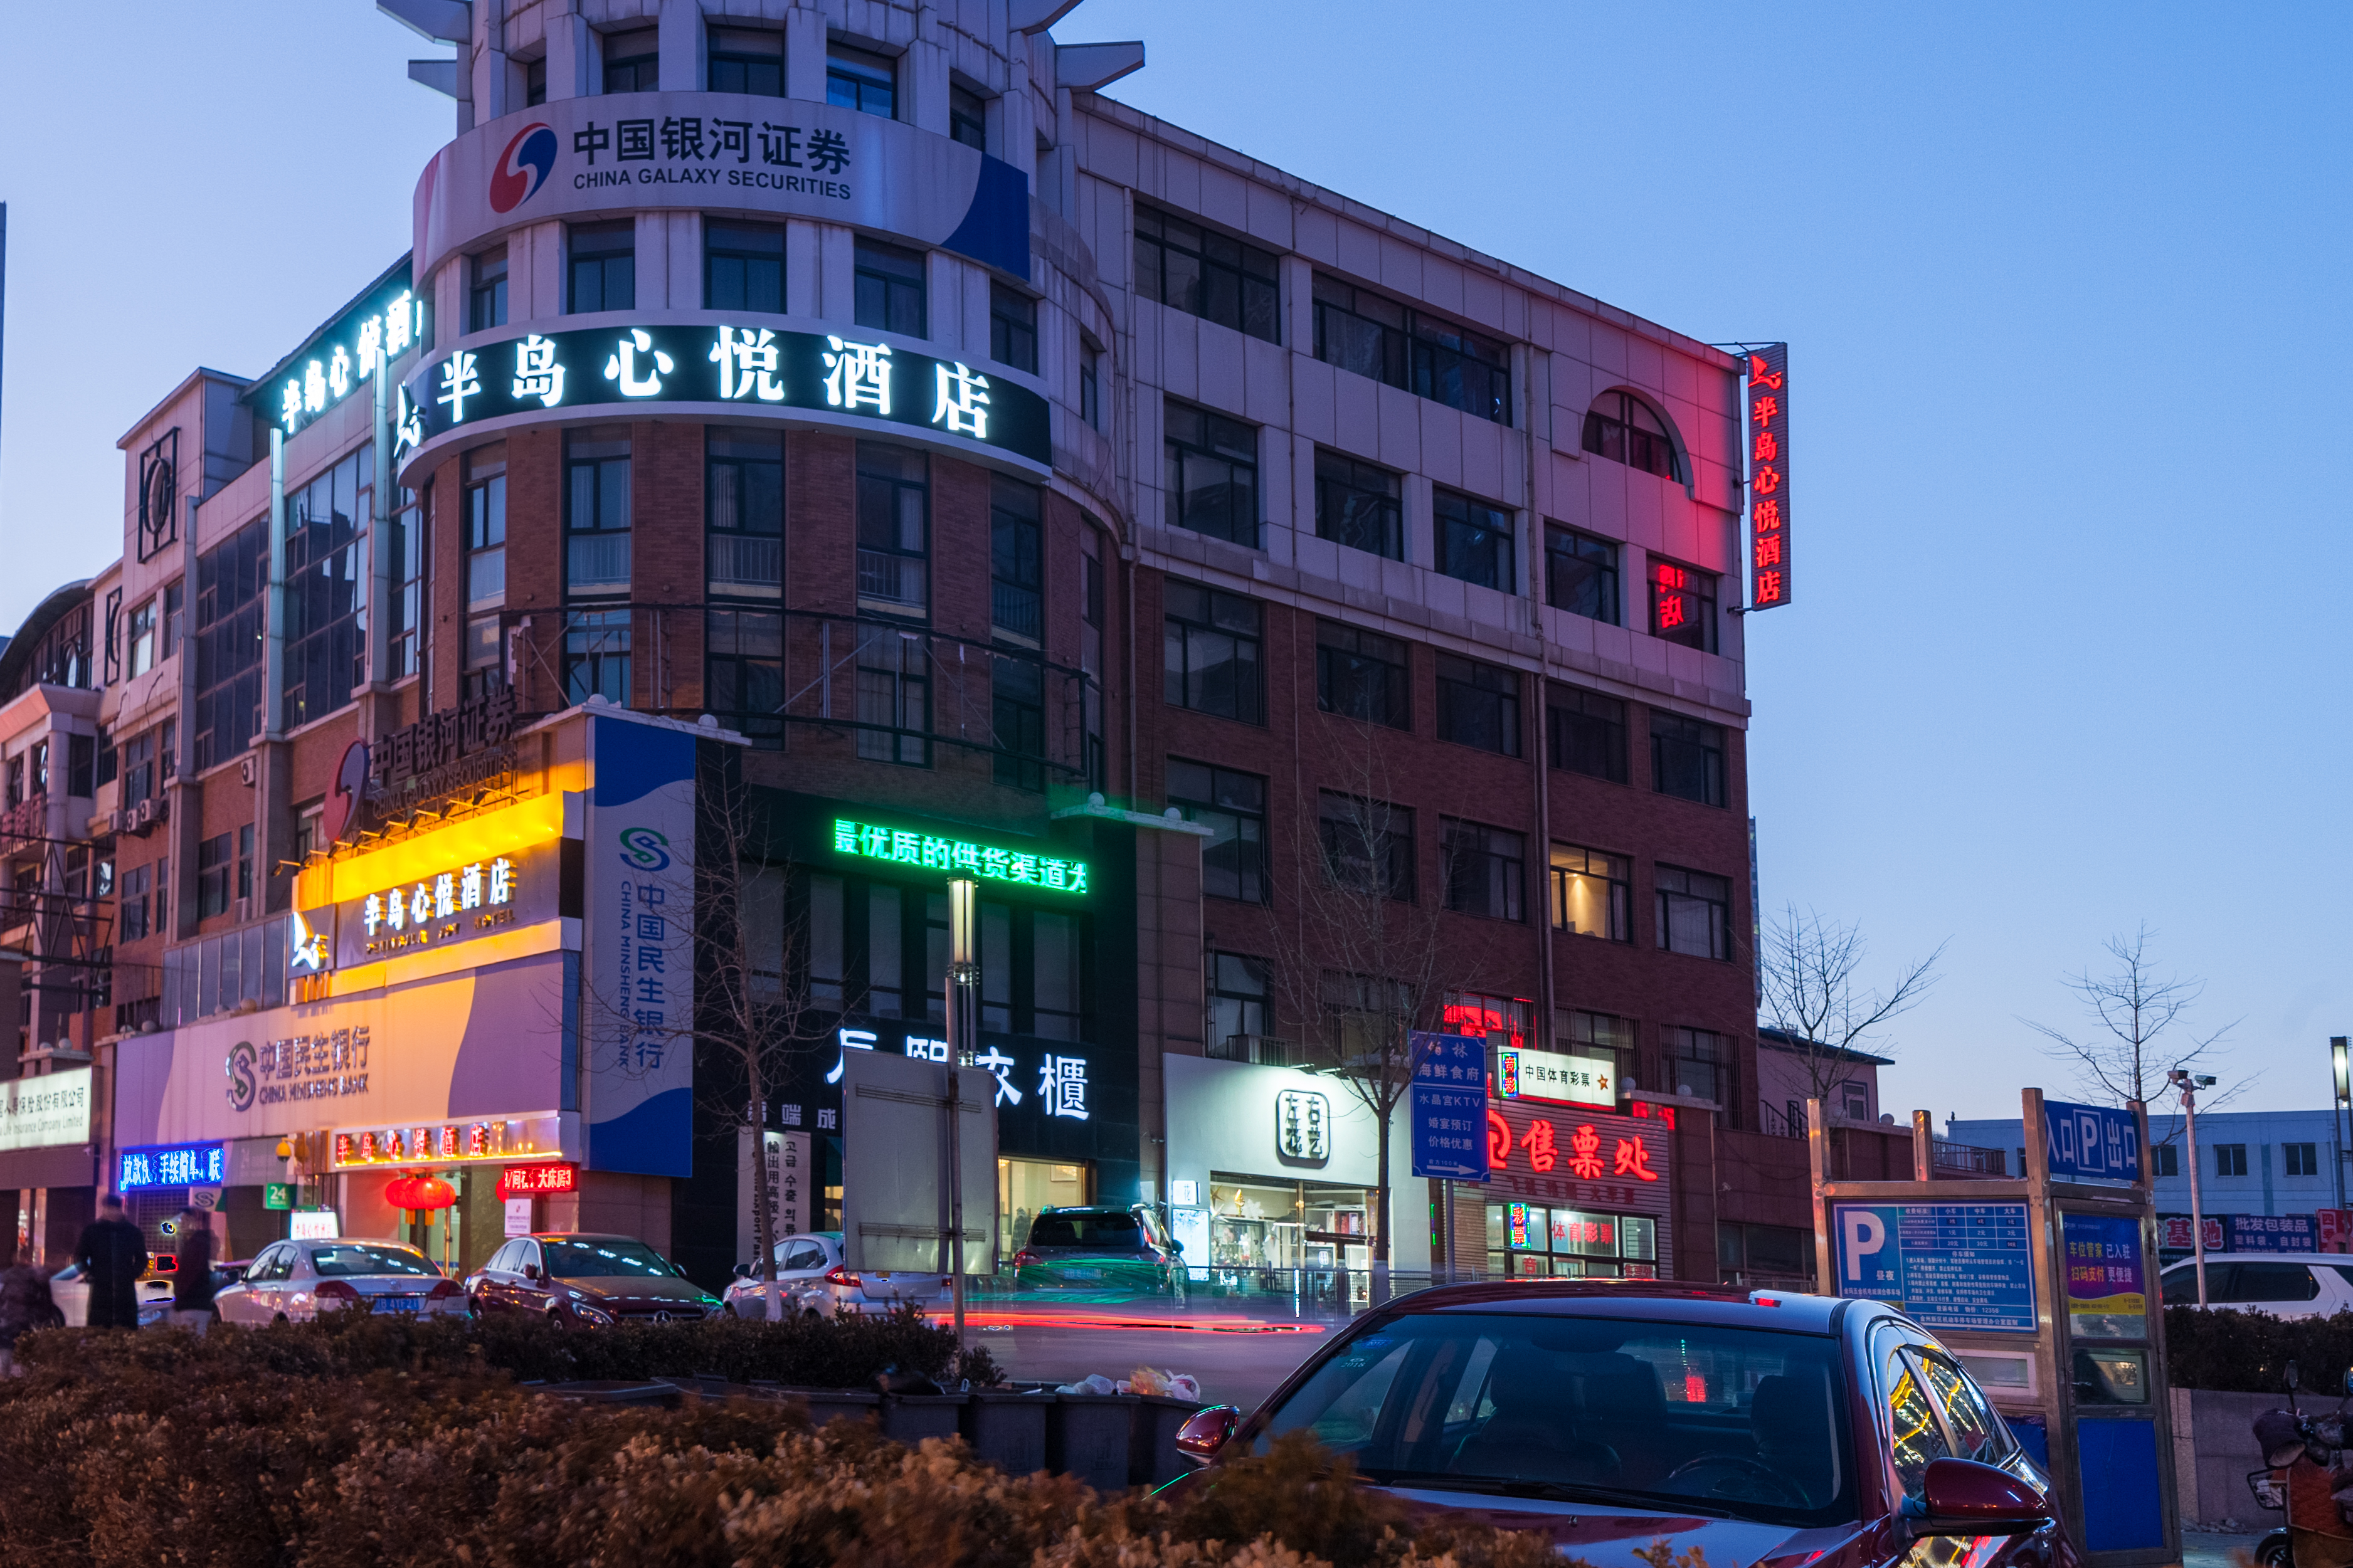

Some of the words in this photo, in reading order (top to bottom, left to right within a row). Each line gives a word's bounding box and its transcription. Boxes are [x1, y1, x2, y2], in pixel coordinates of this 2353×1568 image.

[574, 117, 850, 174] 中国银河证券
[574, 170, 631, 189] CHINA
[638, 168, 721, 184] GALAXY
[727, 170, 851, 200] SECURITIES
[282, 289, 423, 433] 半岛心悦酒
[436, 325, 990, 439] 半岛心悦酒店
[1753, 396, 1780, 604] 半岛心悦酒店
[374, 683, 514, 787] 中国银河证券
[373, 791, 402, 819] CHINA
[405, 769, 448, 806] GALAXY
[447, 744, 514, 787] SECURITIES
[364, 857, 510, 936] 半岛心悦酒店
[621, 881, 631, 930] CHINA
[620, 935, 630, 1018] MINSHENG
[633, 884, 665, 1070] 中国民生银行
[260, 1026, 370, 1080] 中国民生银行
[619, 1024, 630, 1067] BANK
[259, 1085, 287, 1105] CHINA
[288, 1076, 338, 1102] MINSHENG
[339, 1073, 369, 1096] BANK
[1418, 1063, 1479, 1081] 海鲜食府
[1525, 1064, 1590, 1087] 中国体育彩票
[1419, 1093, 1480, 1108] 水晶宫KTV
[337, 1123, 484, 1163] 半岛心悦酒店
[1429, 1117, 1472, 1132] 婚宴预订
[1429, 1135, 1473, 1150] 价格优惠
[2045, 1111, 2075, 1164] 入口
[2081, 1116, 2098, 1165] P
[2107, 1118, 2137, 1171] 出口
[785, 1142, 797, 1168] 고급
[1520, 1120, 1658, 1181] 售票处
[270, 1186, 286, 1200] 24
[785, 1175, 797, 1202] 수출
[785, 1209, 797, 1236] 의류
[1513, 1207, 1525, 1244] 彩票
[1552, 1220, 1615, 1244] 体育彩票
[2234, 1217, 2309, 1233] 批发包装品
[1844, 1211, 1885, 1281] P
[2069, 1241, 2103, 1258] 车位管家
[2106, 1243, 2131, 1260] 已入驻
[1876, 1270, 1895, 1281] 昼夜
[2071, 1266, 2104, 1282] 扫码支付
[2107, 1266, 2132, 1283] 更便捷
